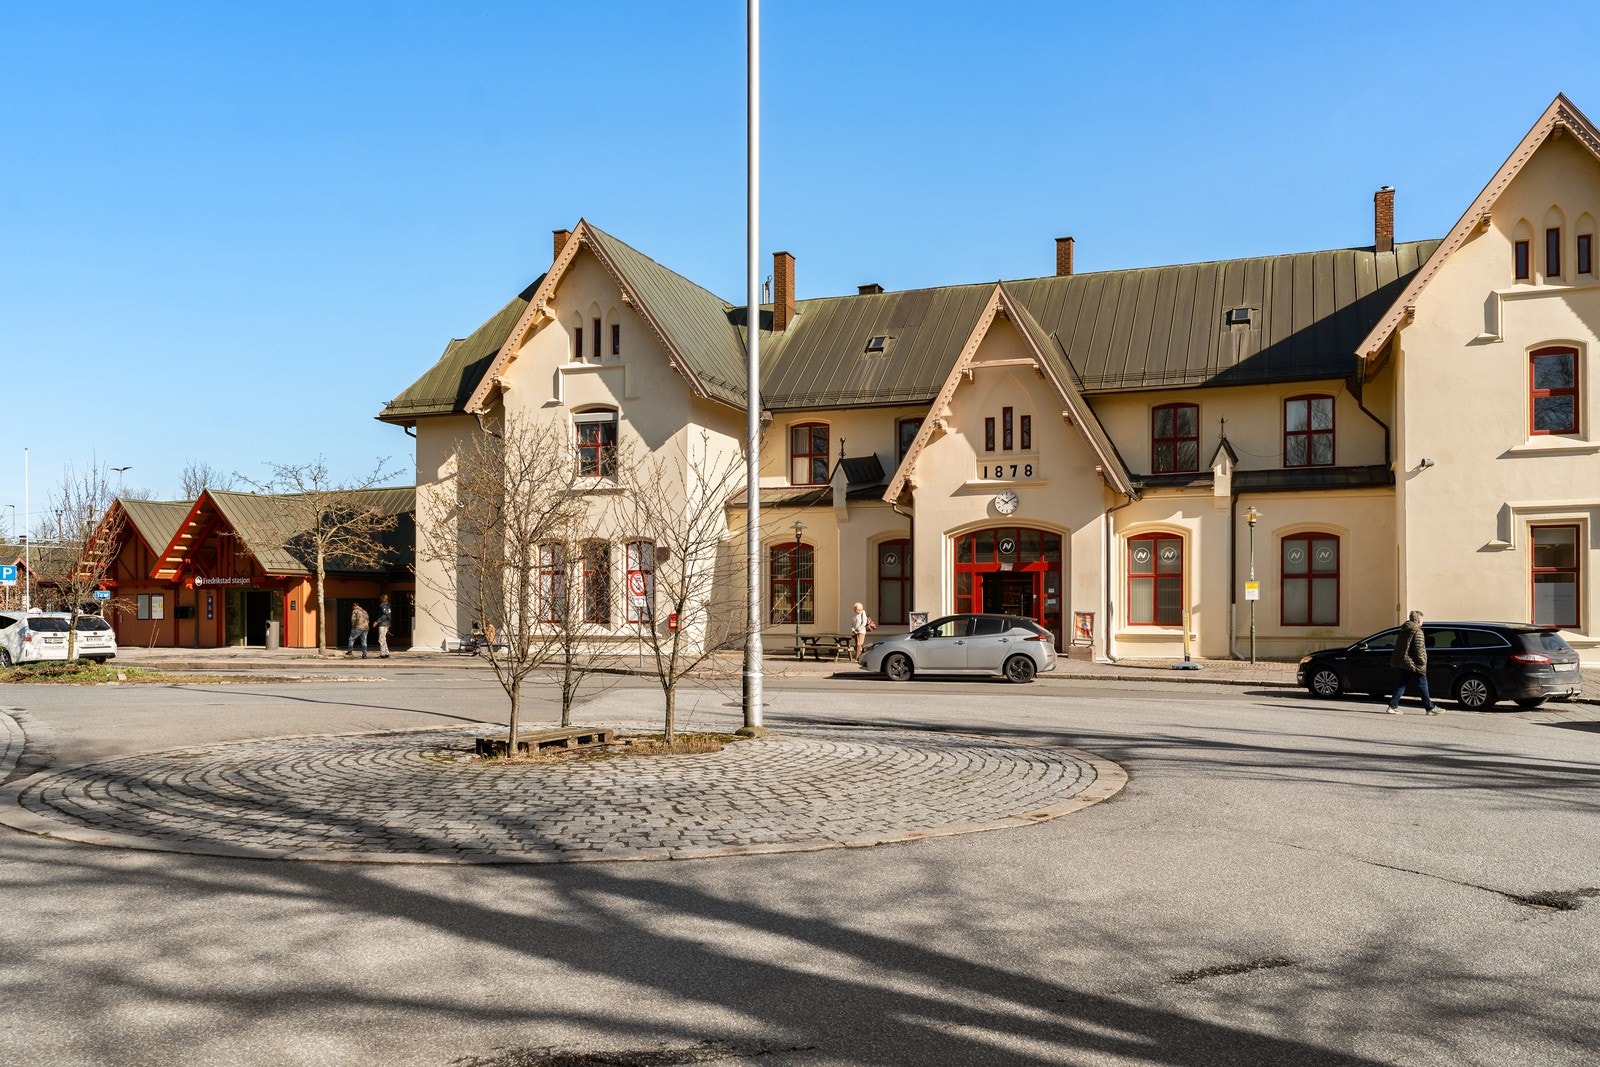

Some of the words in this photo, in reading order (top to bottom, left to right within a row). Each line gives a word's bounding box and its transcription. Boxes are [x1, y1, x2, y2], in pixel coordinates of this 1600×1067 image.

[984, 464, 1033, 479] 1878
[2, 567, 13, 579] P
[203, 576, 231, 585] Fredrikstad
[231, 577, 251, 586] stasjon
